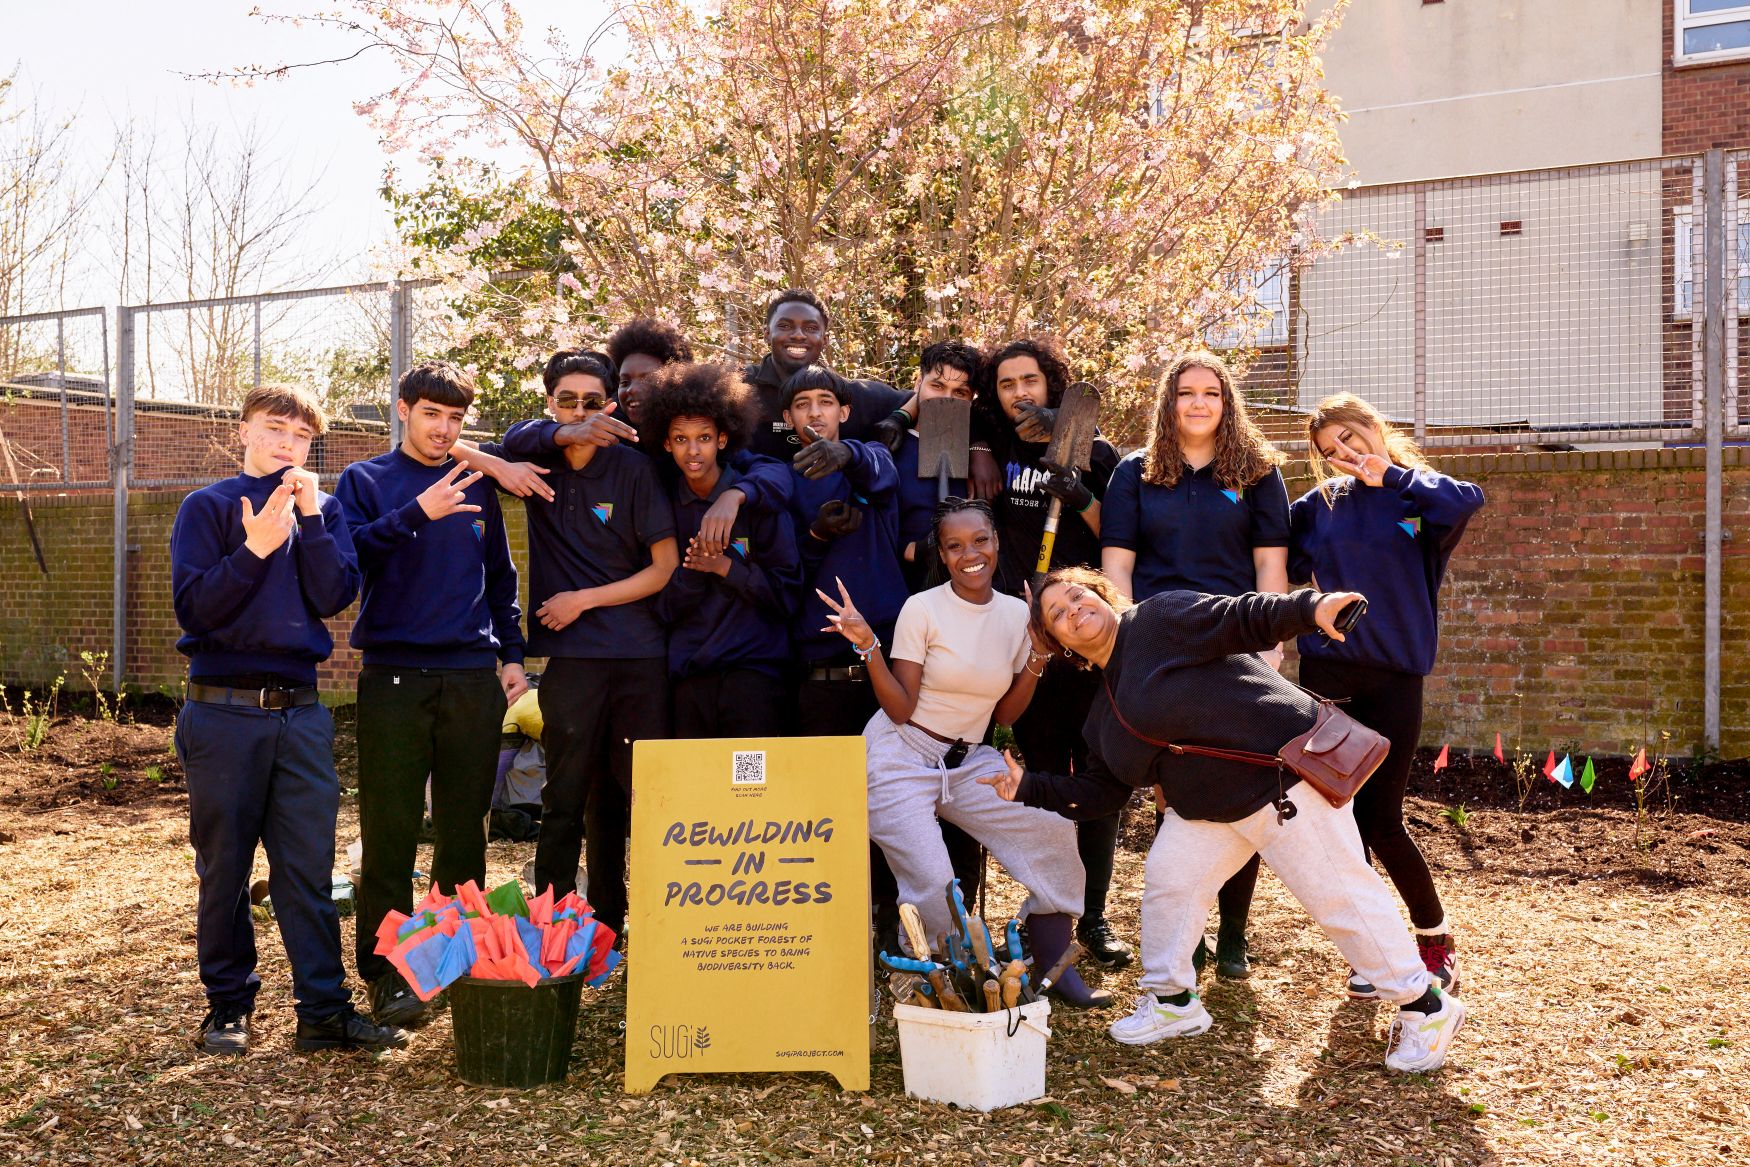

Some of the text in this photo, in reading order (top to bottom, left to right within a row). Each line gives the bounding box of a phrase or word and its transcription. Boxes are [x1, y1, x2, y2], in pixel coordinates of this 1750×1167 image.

[1006, 461, 1056, 495] TRAPS
[662, 817, 833, 847] REWILDING
[731, 851, 765, 875] IN
[664, 879, 833, 907] PROGRESS
[722, 923, 742, 932] ARE
[745, 922, 788, 931] BUILDING
[681, 937, 687, 945] A
[716, 936, 755, 945] POCKET
[757, 935, 797, 944] FOREST
[799, 934, 813, 943] OF
[682, 947, 810, 958] NATIVE SPECIES TO BRING
[697, 961, 796, 971] BIODIVERSITY BACK.
